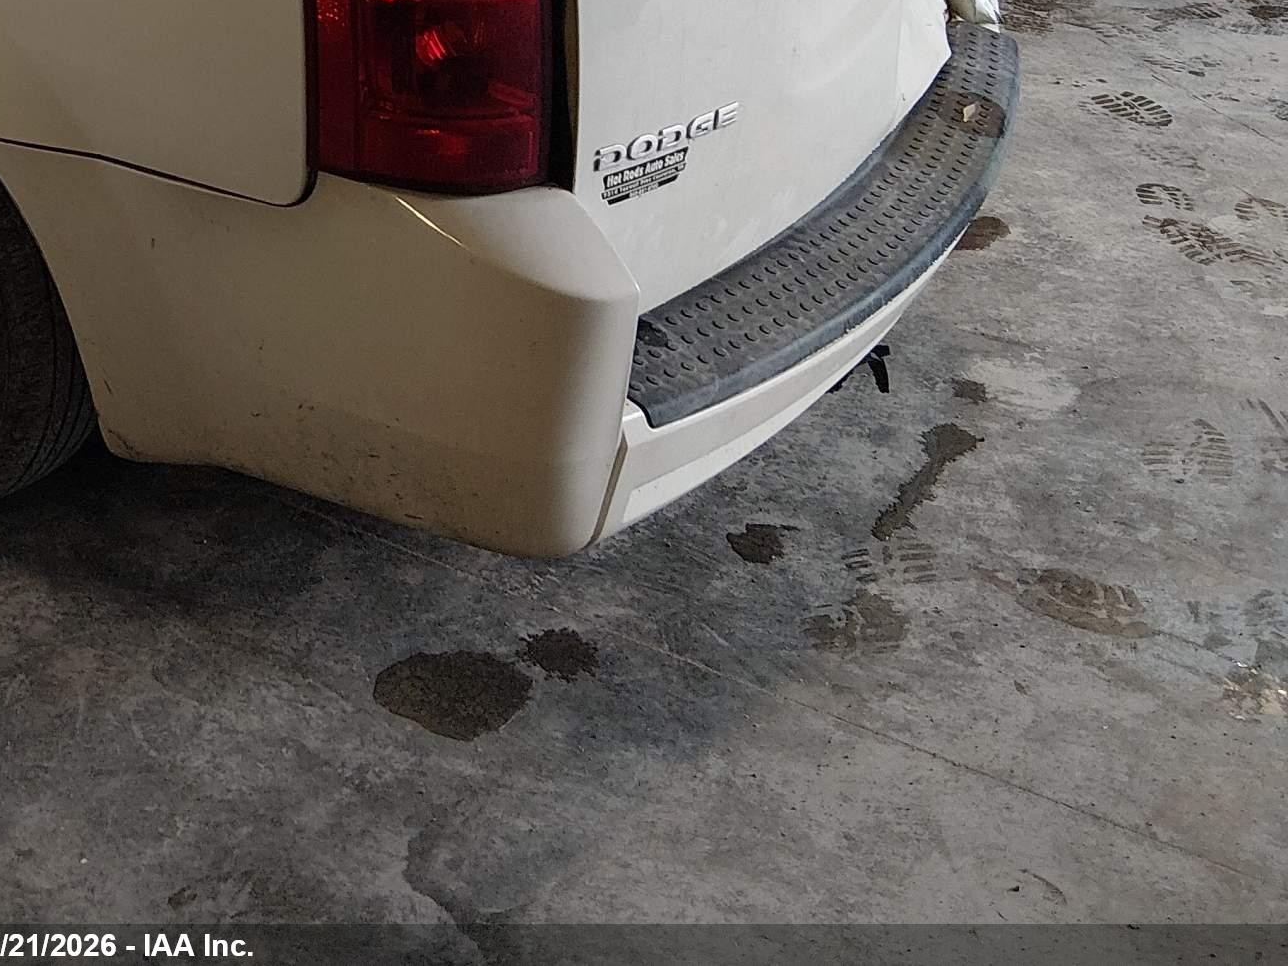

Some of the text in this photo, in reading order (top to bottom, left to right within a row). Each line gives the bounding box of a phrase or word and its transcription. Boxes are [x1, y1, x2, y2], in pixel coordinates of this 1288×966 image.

[593, 100, 740, 172] DODGE
[606, 172, 622, 188] Hot
[623, 165, 644, 182] Rods
[645, 159, 664, 174] Auto
[664, 151, 684, 167] Sales
